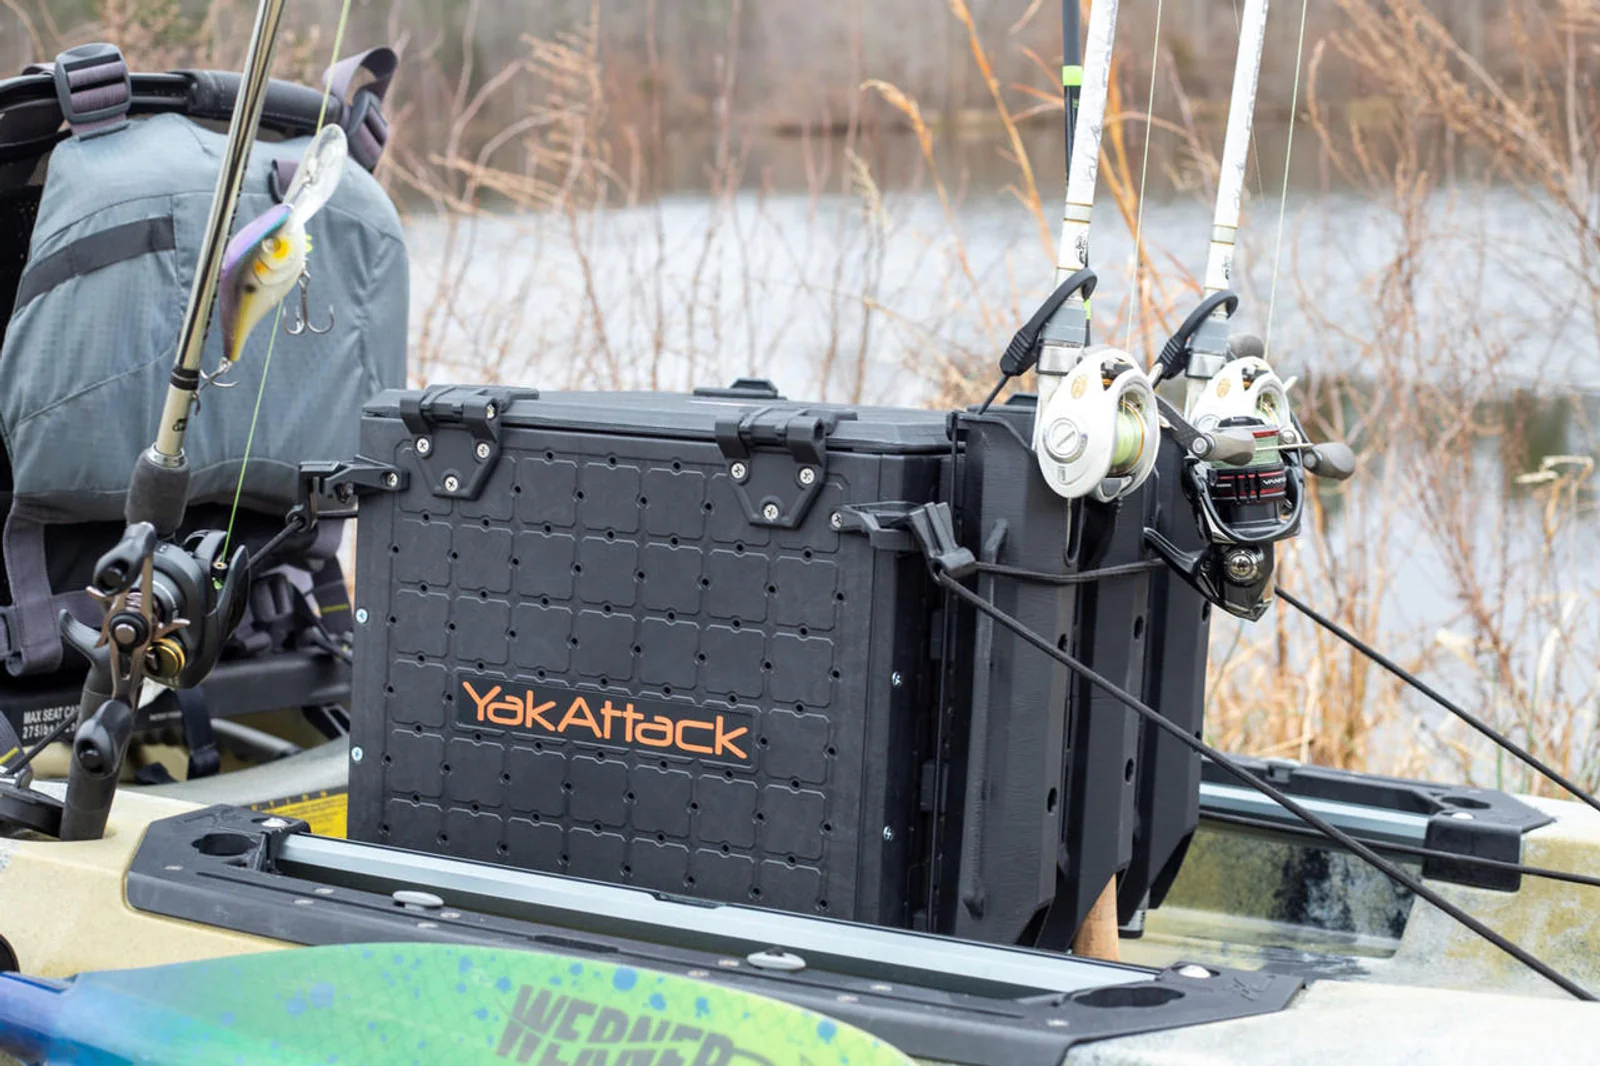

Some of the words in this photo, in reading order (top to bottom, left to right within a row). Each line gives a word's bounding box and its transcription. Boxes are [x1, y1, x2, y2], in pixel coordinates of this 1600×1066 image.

[23, 710, 42, 724] MAX
[43, 706, 63, 722] SEAT
[462, 681, 749, 760] YakAttack
